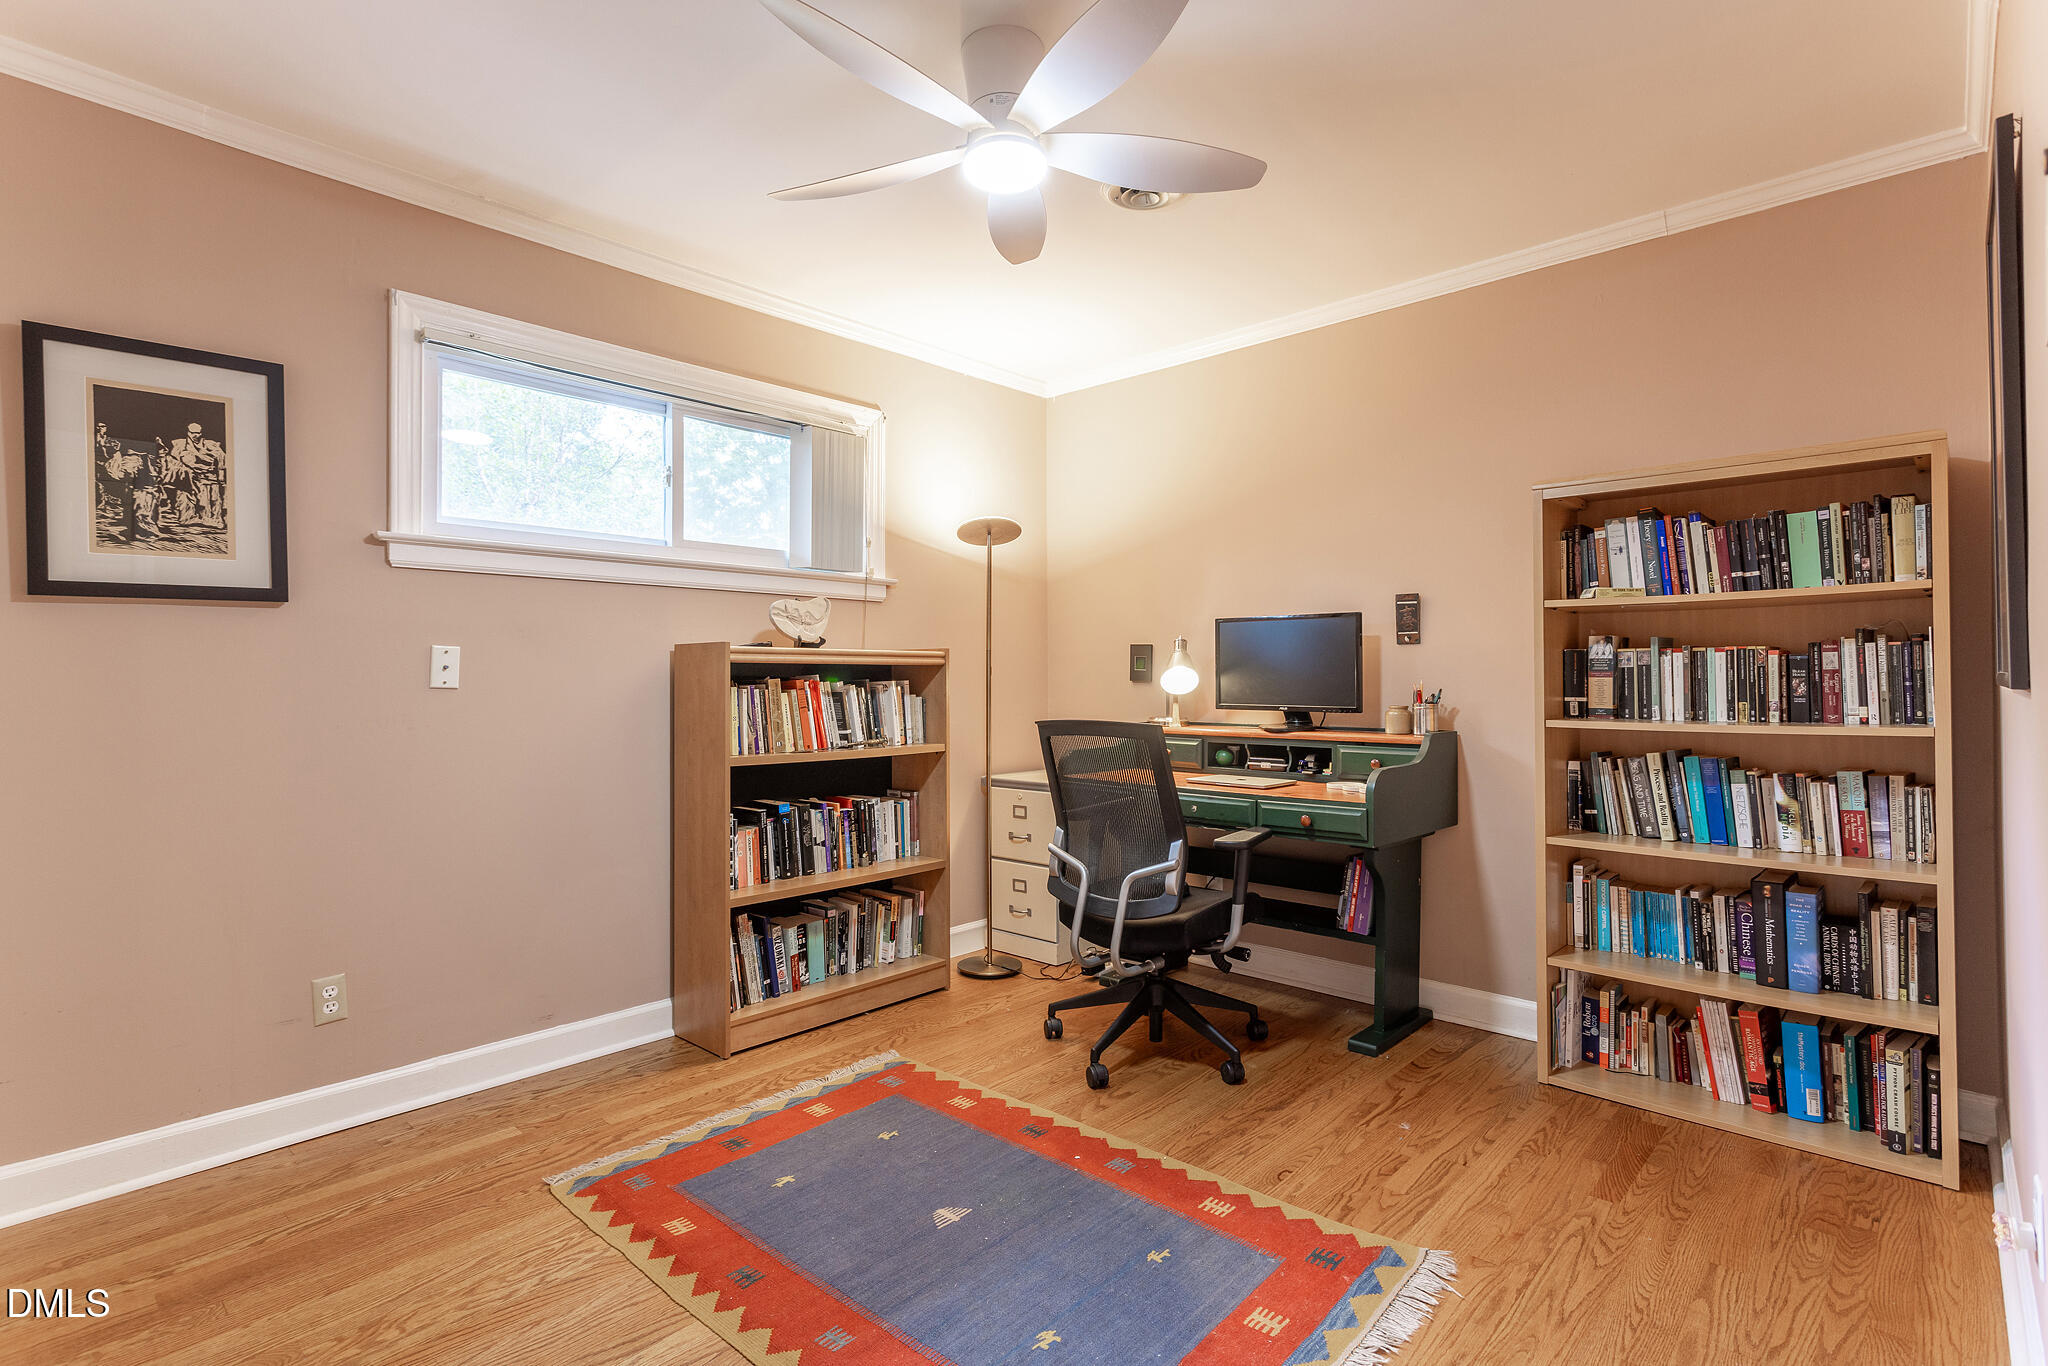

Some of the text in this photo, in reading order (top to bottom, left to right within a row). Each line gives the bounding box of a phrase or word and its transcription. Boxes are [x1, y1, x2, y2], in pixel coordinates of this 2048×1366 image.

[1643, 519, 1653, 542] Theory
[1648, 561, 1657, 579] Novel
[1634, 783, 1644, 798] AND
[1653, 769, 1661, 792] Process
[1660, 805, 1669, 826] Reality
[1840, 787, 1848, 804] SADE
[1852, 774, 1862, 807] MARQUIS
[1637, 800, 1648, 818] TIME
[1741, 913, 1754, 956] Chinese
[1765, 918, 1776, 965] Mathematics
[1889, 914, 1897, 946] CALCULUS
[774, 936, 784, 970] UZUMAKI
[1822, 926, 1832, 976] ANIMAL IDIOMS
[1830, 926, 1840, 986] CARDS OF CHINESE
[1745, 1028, 1755, 1059] ROMANTIC
[1913, 1078, 1921, 1104] TRADING
